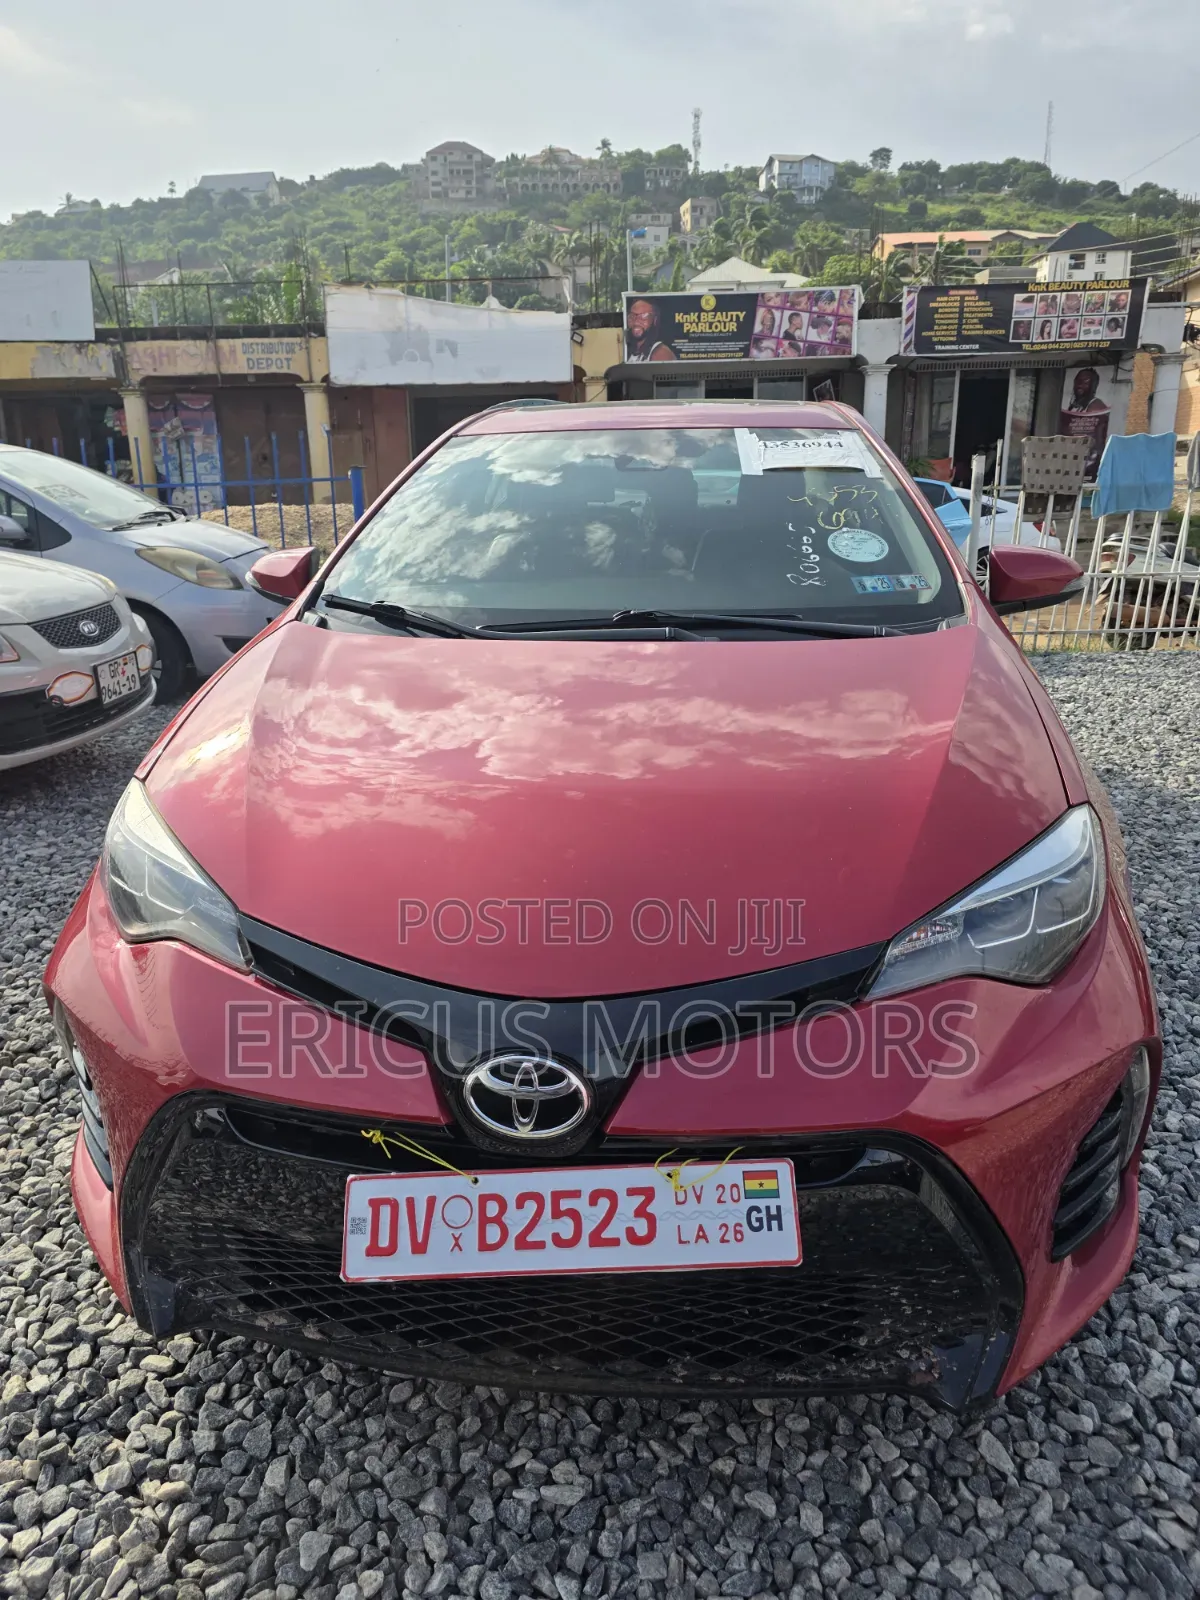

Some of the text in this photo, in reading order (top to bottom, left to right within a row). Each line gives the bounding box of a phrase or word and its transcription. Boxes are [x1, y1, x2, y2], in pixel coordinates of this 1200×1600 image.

[1028, 280, 1130, 292] KnK BEAUTY PARLOUR
[675, 311, 746, 323] KnK BEAUTY
[683, 322, 737, 333] PARLOUR
[247, 357, 293, 370] DEPOT
[108, 661, 120, 679] GR
[101, 674, 137, 702] 9641-19
[674, 1183, 741, 1206] DV 20
[365, 1186, 657, 1257] DV B2523
[746, 1204, 784, 1232] GH
[677, 1222, 744, 1245] LA 26
